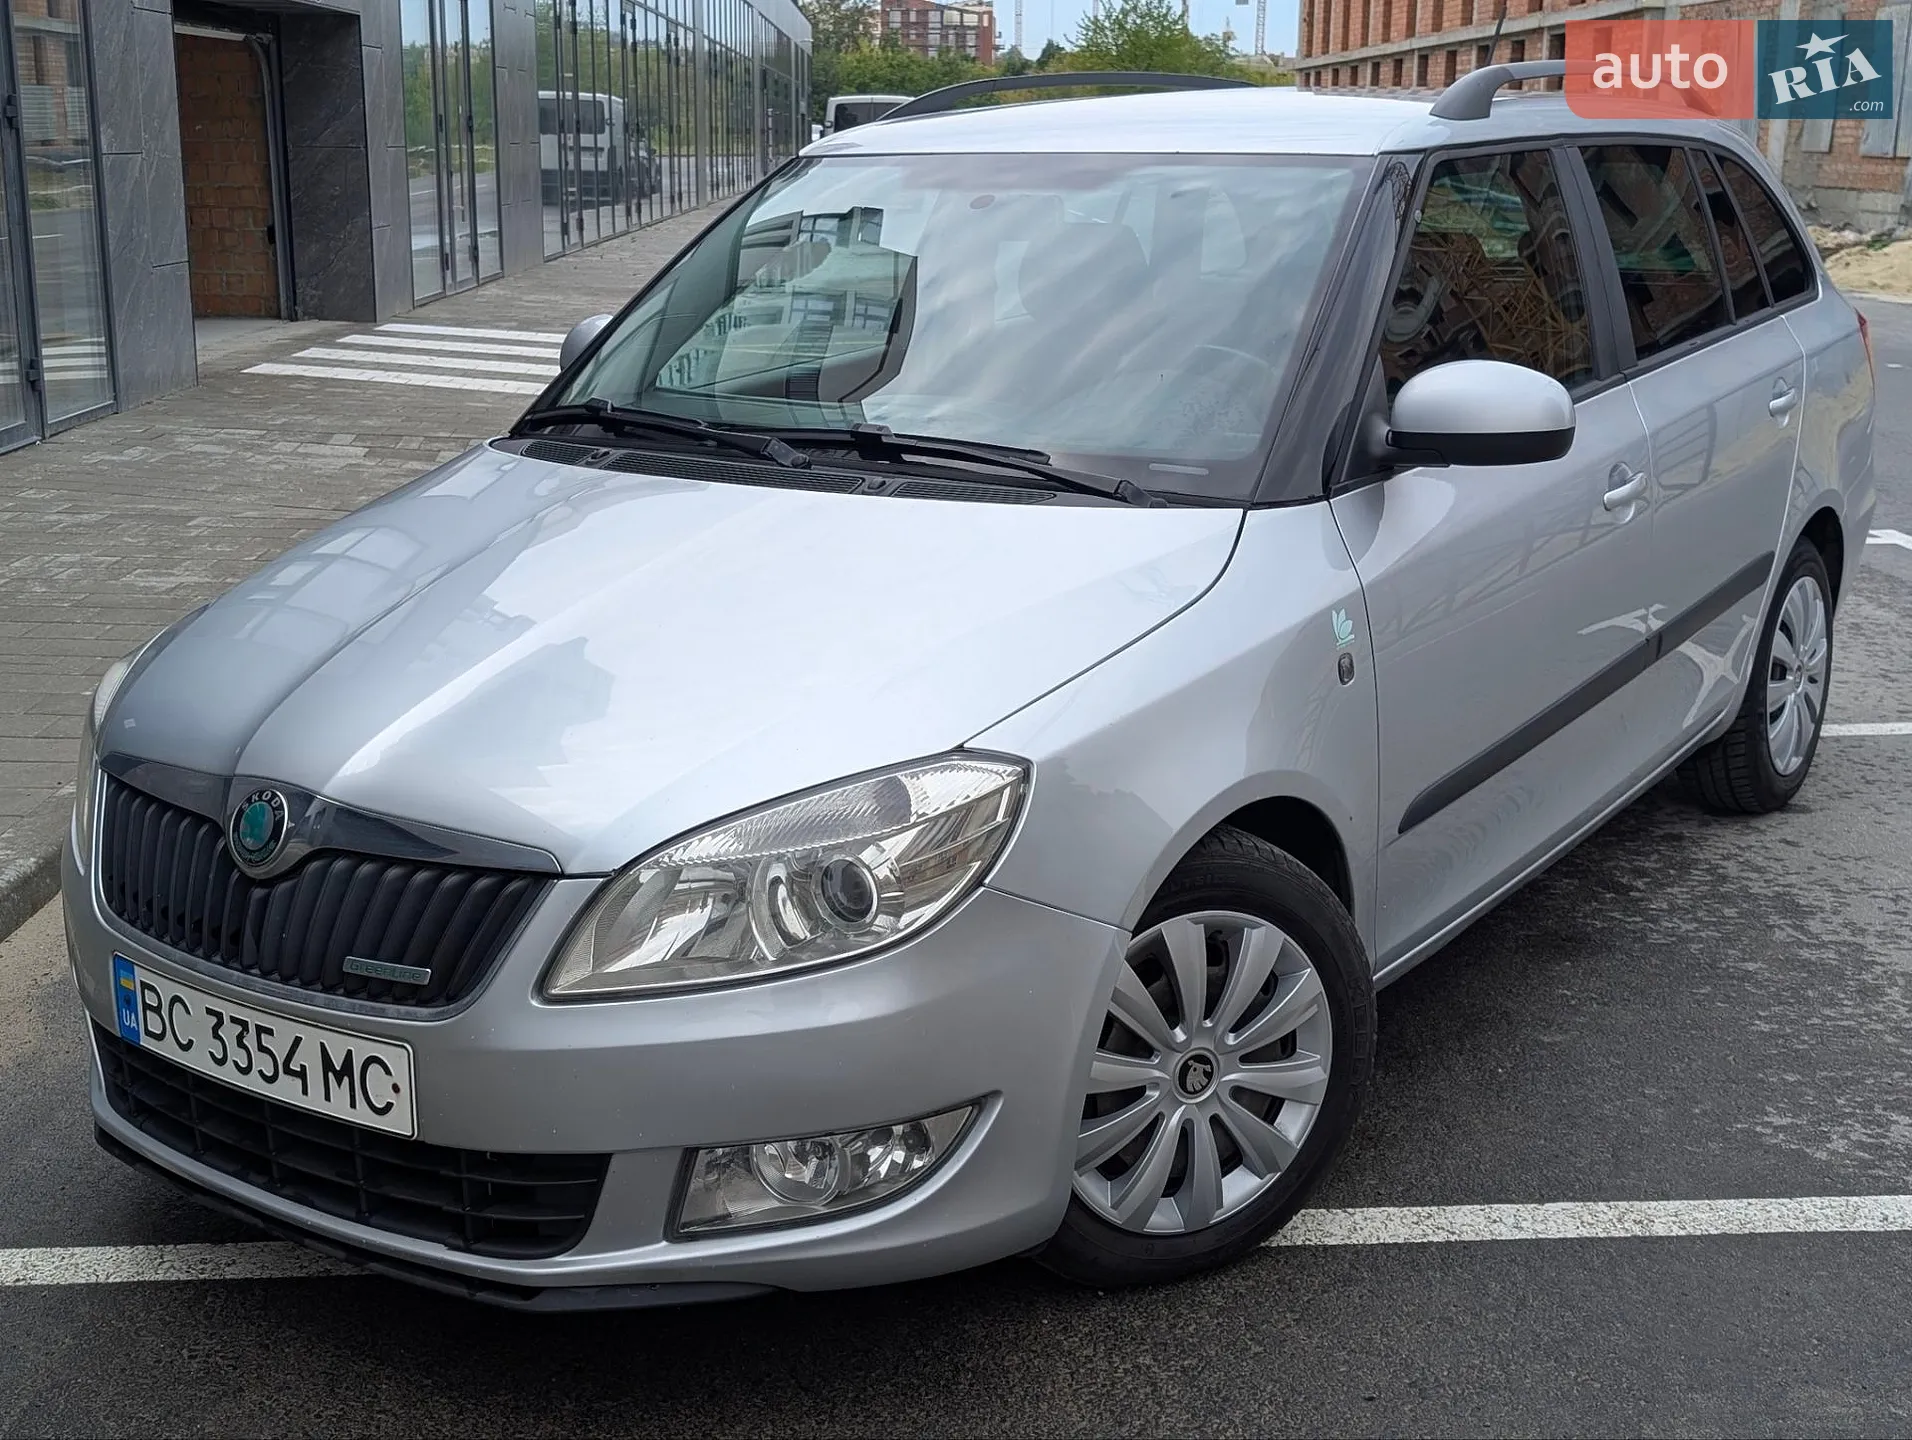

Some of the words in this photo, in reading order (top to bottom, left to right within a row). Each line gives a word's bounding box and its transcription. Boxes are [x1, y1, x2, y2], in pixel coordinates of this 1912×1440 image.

[122, 1010, 138, 1030] UA
[139, 980, 194, 1052] BC
[205, 1005, 309, 1097] 3354
[320, 1040, 395, 1116] MC
